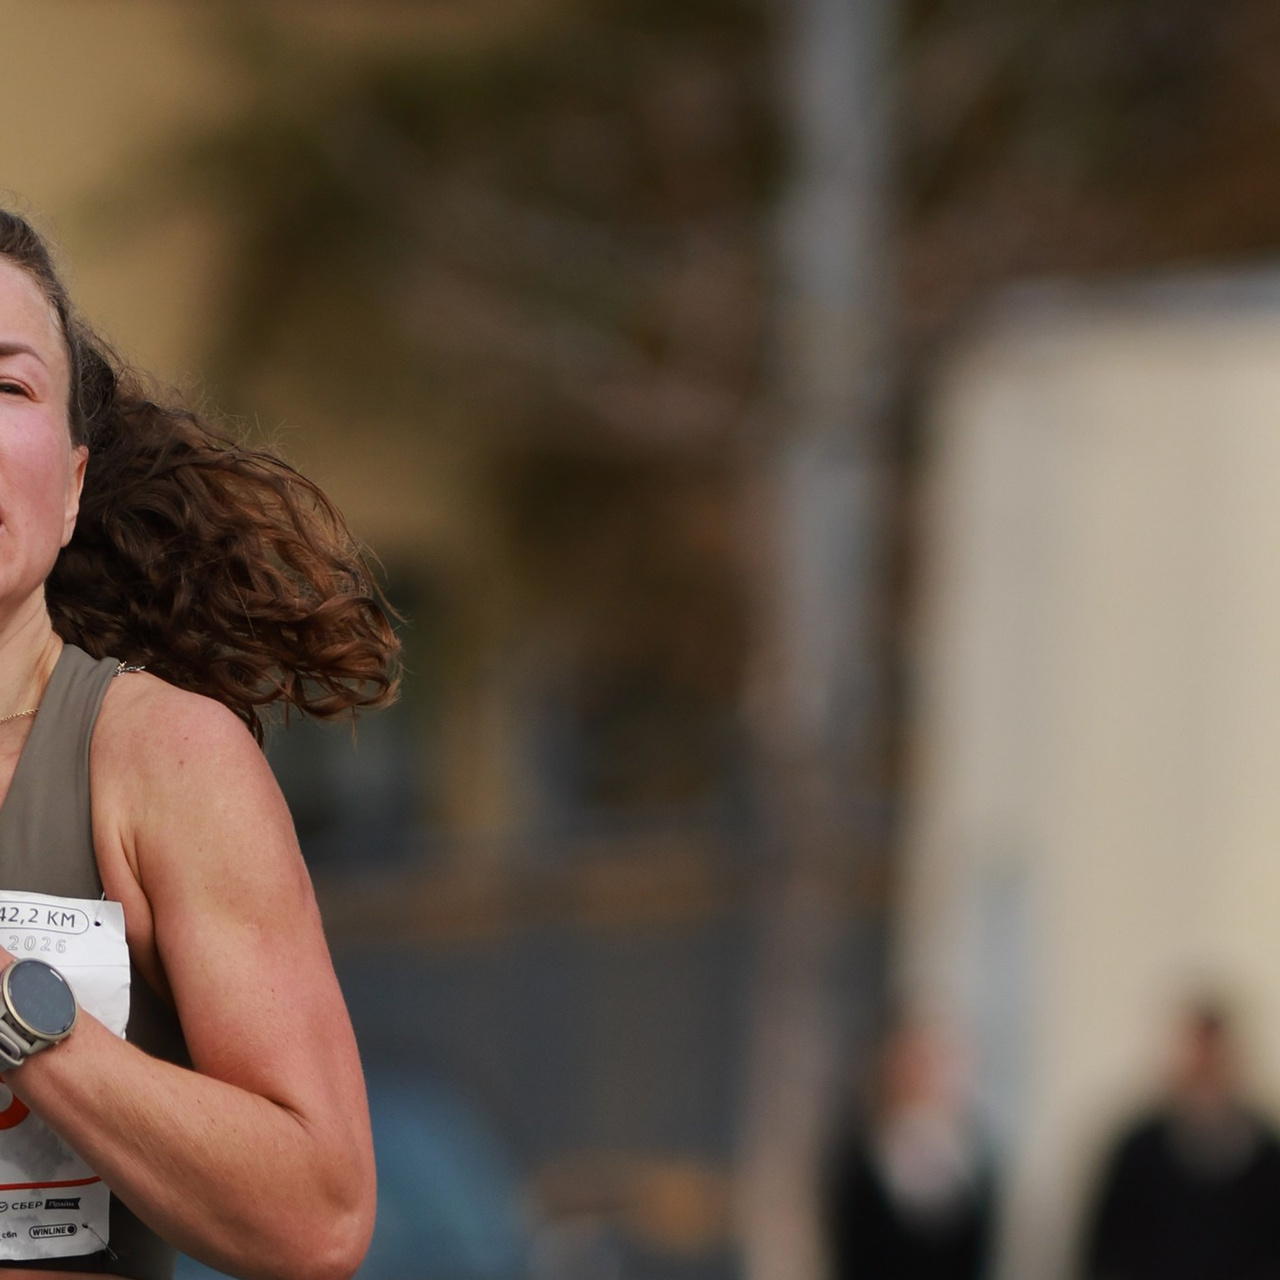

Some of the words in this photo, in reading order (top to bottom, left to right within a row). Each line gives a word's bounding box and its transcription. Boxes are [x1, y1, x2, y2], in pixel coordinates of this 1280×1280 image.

[7, 935, 67, 954] 2026
[11, 1201, 43, 1211] СБЕР
[2, 1231, 18, 1239] сбп
[32, 1226, 67, 1236] WINLINE
